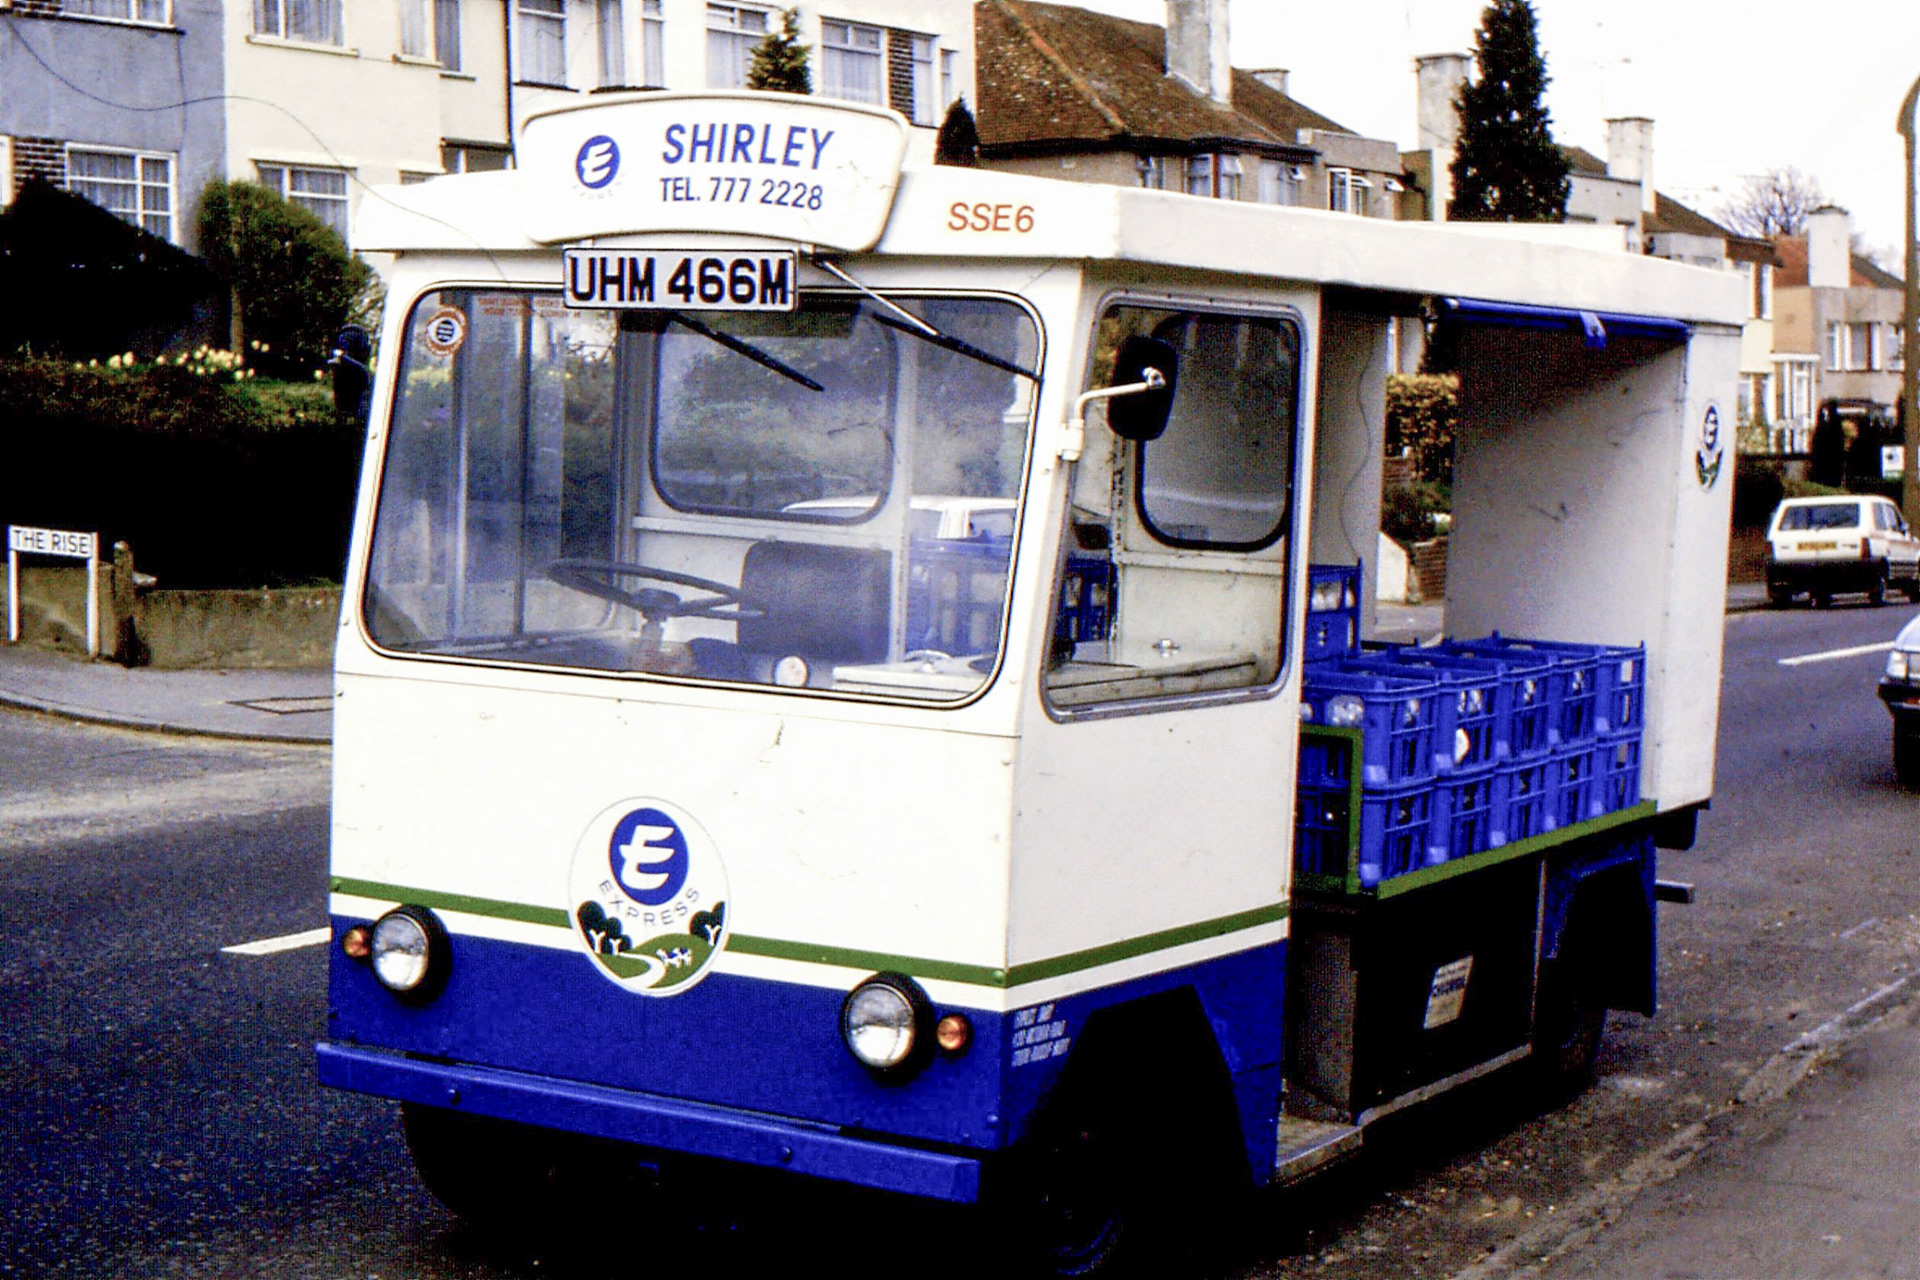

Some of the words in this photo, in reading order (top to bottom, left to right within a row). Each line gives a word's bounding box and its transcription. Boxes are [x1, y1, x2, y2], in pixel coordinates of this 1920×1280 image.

[662, 123, 835, 170] SHIRLEY
[660, 177, 701, 202] TEL.
[709, 176, 752, 203] 777
[759, 178, 823, 211] 2228
[947, 202, 1035, 233] SSE6
[569, 256, 656, 302] UHM
[667, 257, 790, 305] 466M
[13, 529, 44, 549] THE
[51, 532, 88, 555] RISE
[599, 880, 699, 926] EXPRESS
